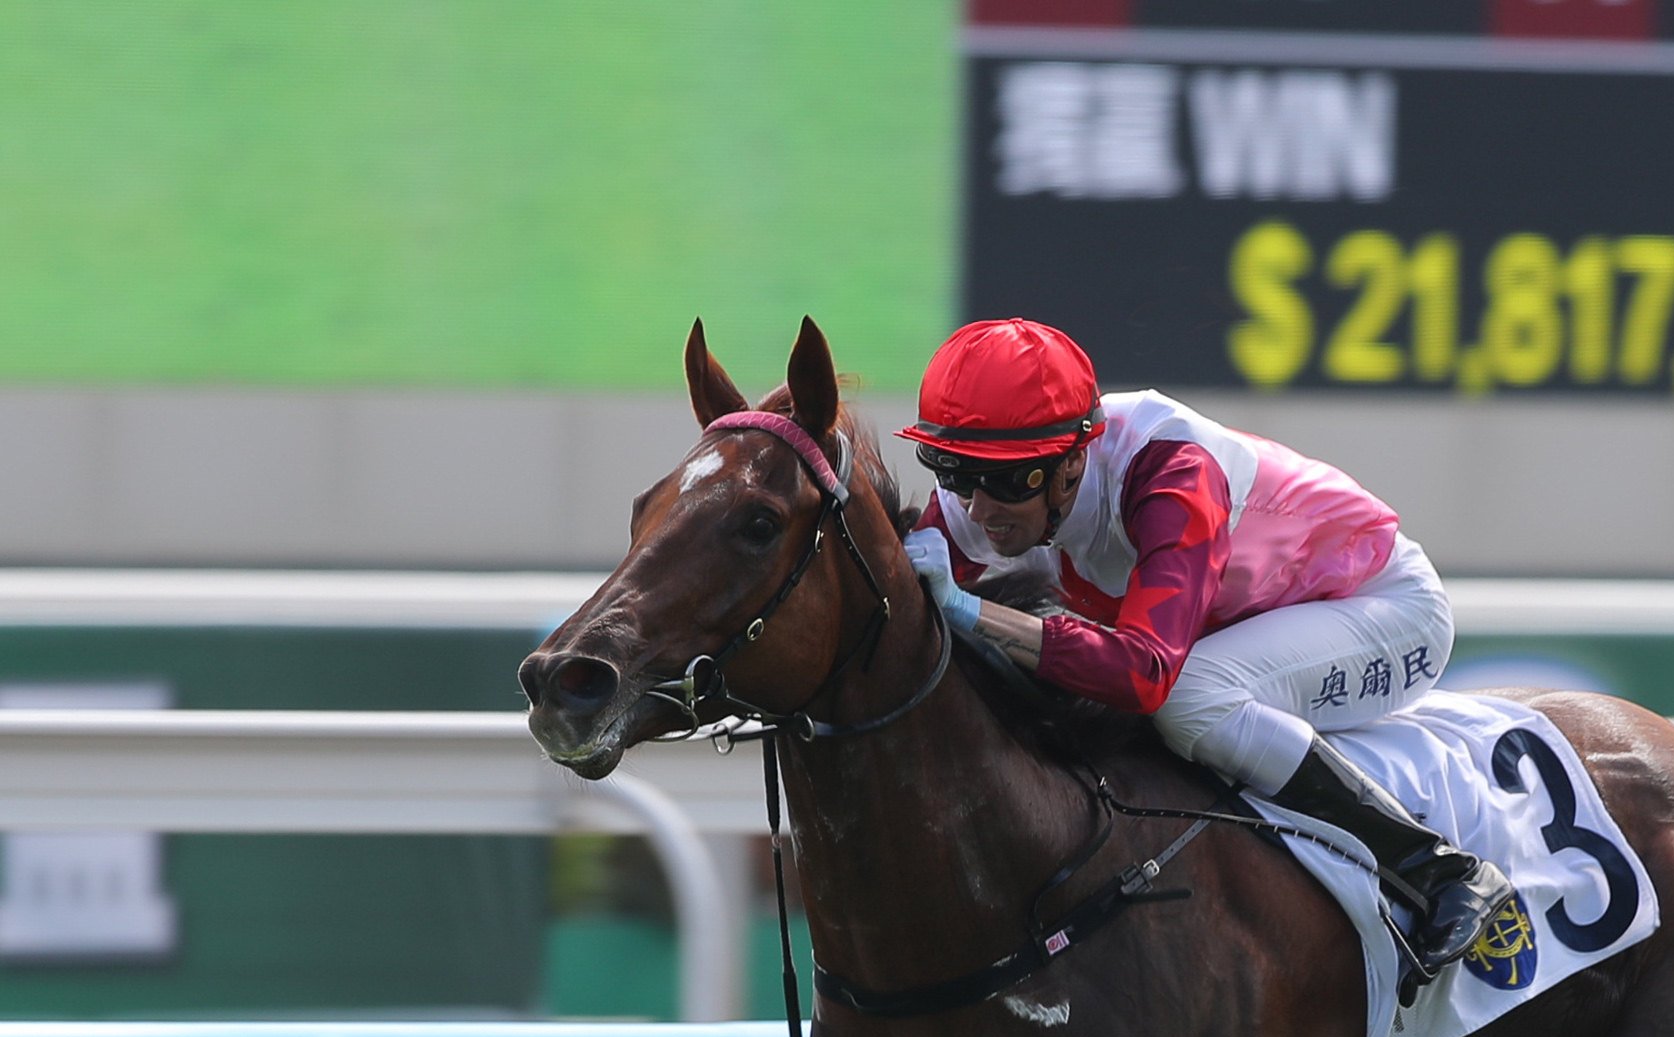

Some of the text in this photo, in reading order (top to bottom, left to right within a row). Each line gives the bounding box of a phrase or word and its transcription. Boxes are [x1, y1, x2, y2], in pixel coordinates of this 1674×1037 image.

[1190, 68, 1397, 202] WIN
[1310, 644, 1440, 711] 奧爾民
[1491, 728, 1639, 953] 3
